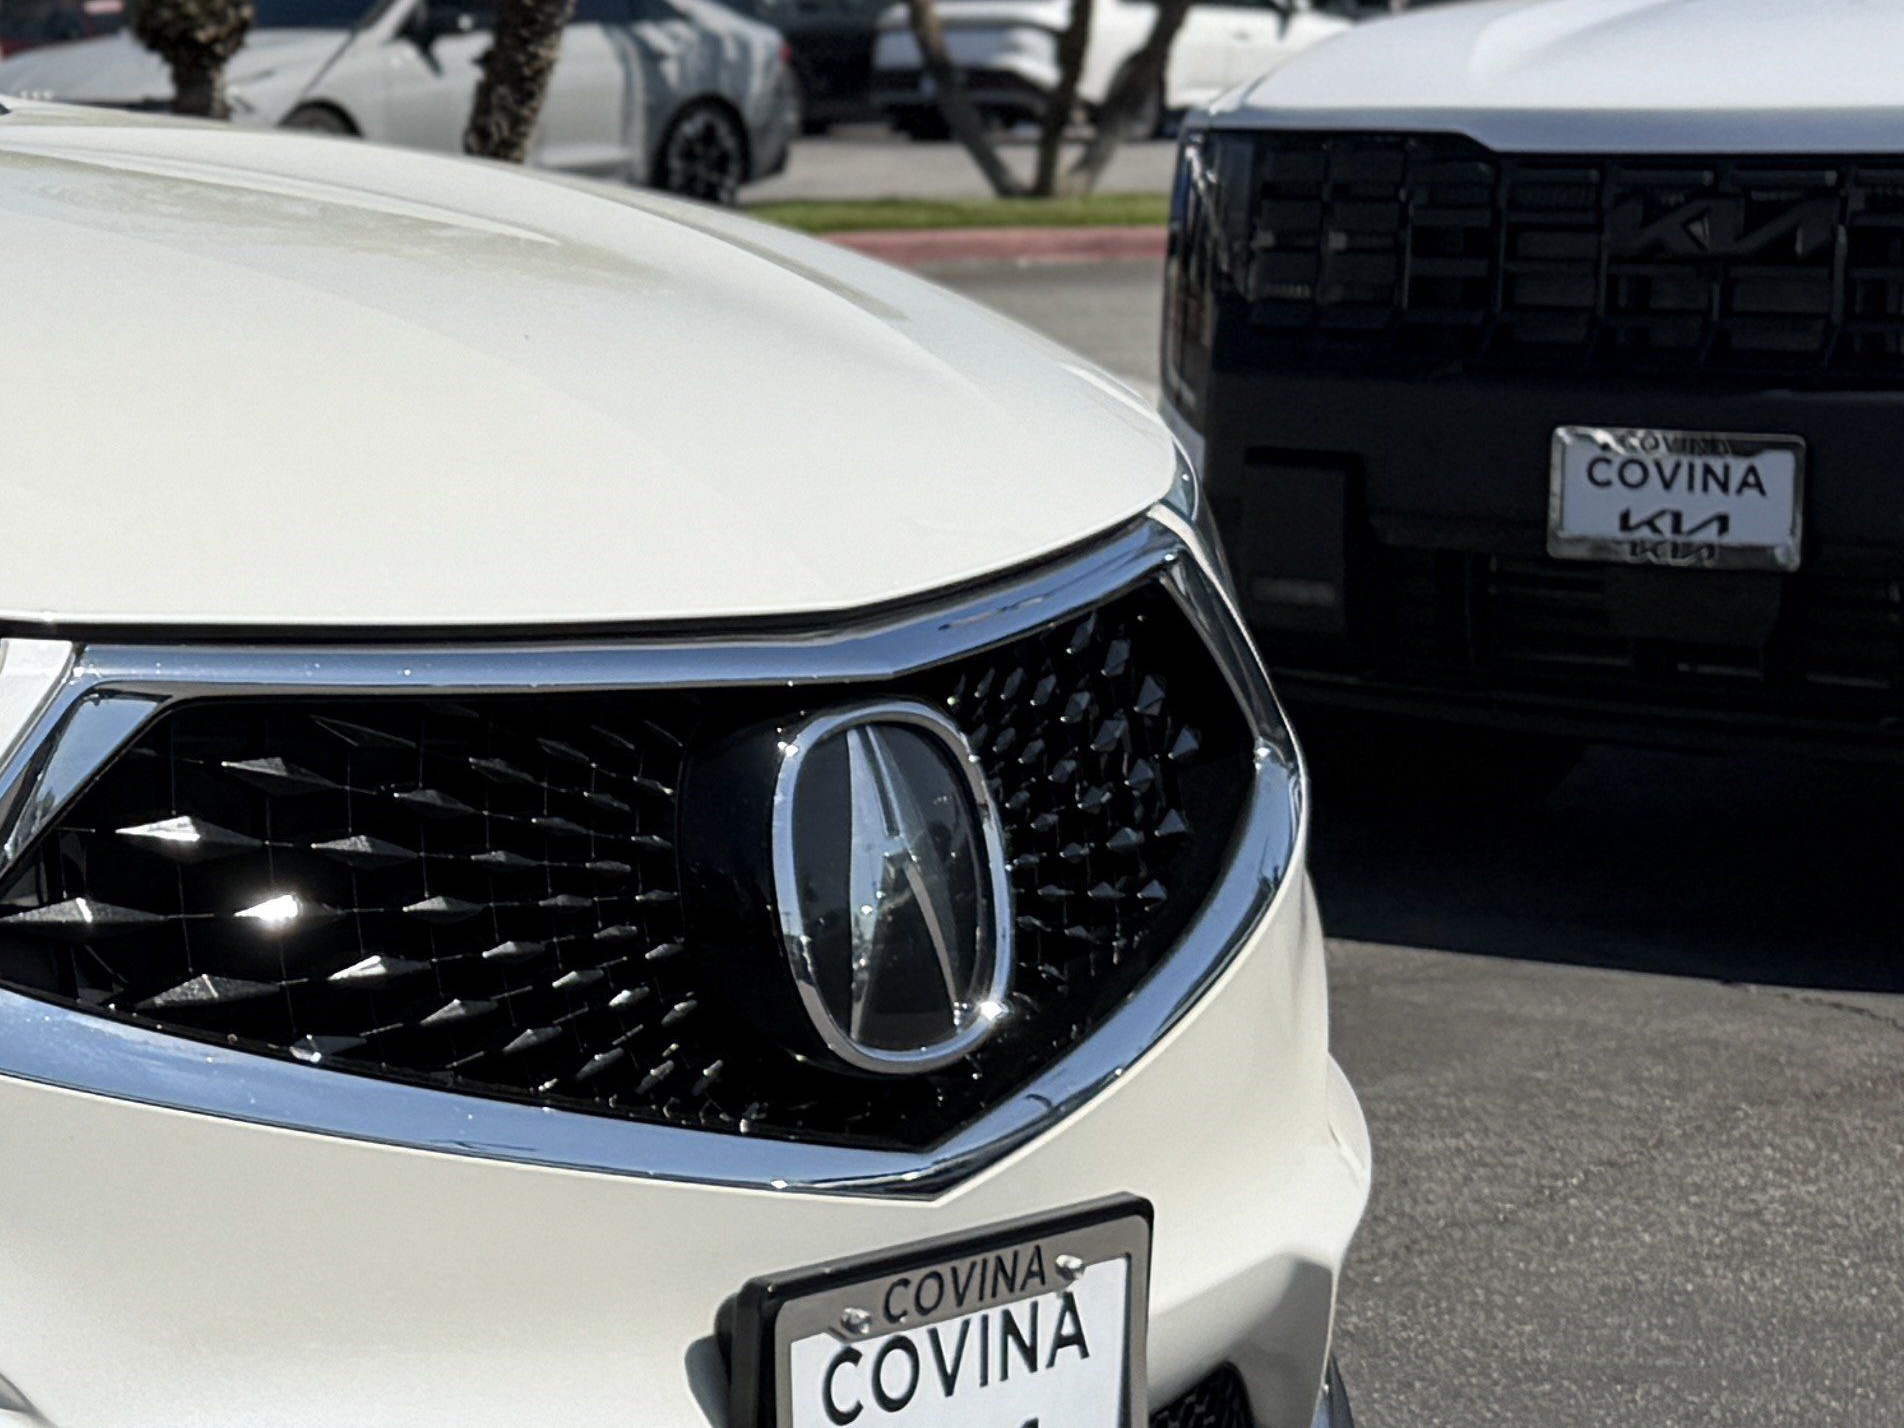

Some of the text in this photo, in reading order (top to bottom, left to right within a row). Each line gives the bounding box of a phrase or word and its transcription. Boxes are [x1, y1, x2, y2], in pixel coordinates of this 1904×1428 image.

[1586, 456, 1768, 498] COVINA
[883, 1244, 1048, 1325] COVINA
[822, 1291, 1091, 1427] COVINA
